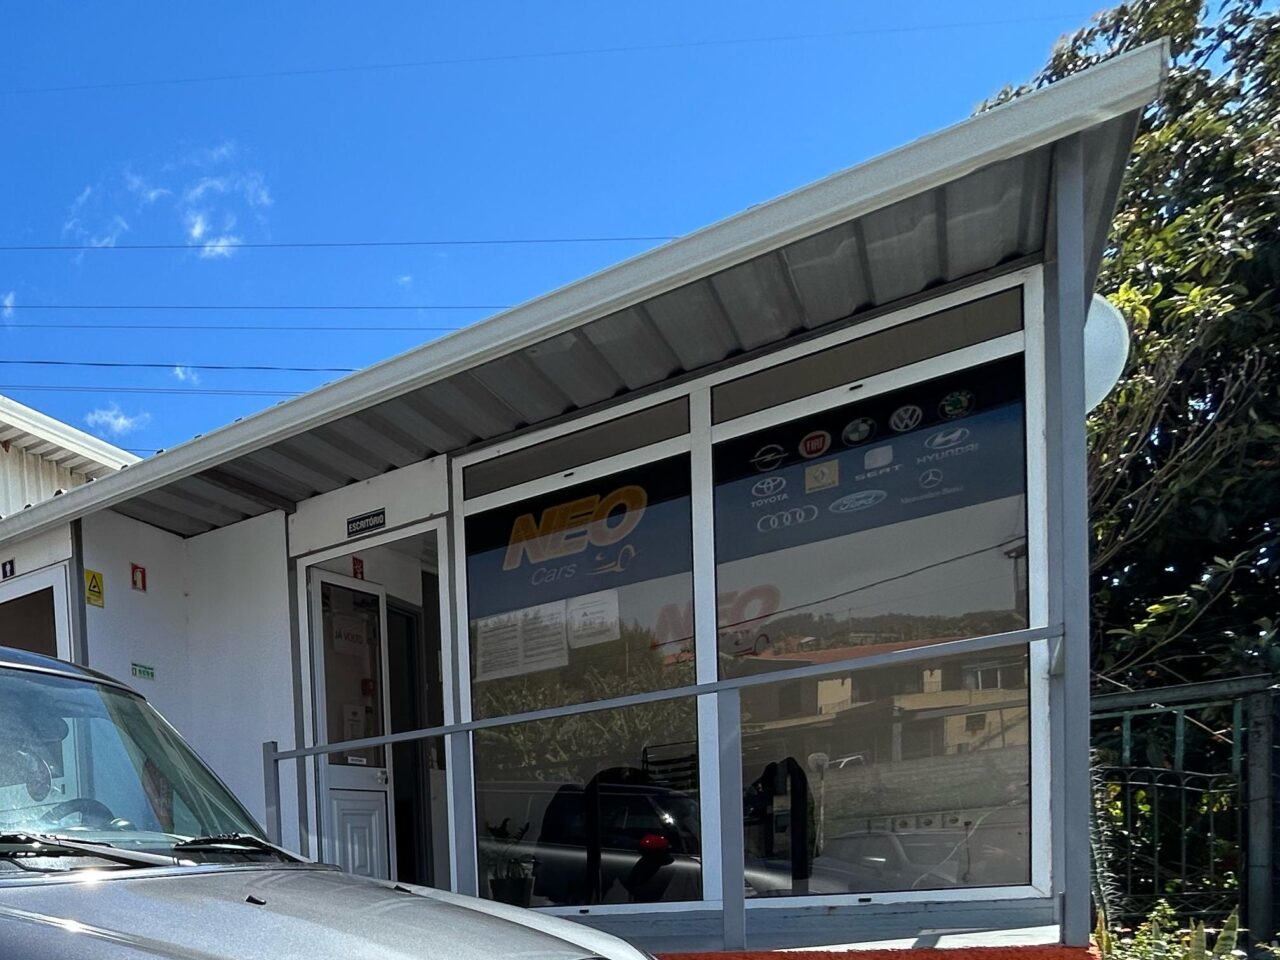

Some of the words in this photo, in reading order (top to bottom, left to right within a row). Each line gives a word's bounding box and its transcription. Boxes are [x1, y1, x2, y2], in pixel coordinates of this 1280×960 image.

[805, 436, 824, 453] FIAT
[916, 443, 979, 465] HYUNDAI
[855, 463, 903, 482] SEAT
[751, 493, 789, 508] TOYOTA
[502, 485, 648, 571] NEO
[531, 562, 577, 586] Cars
